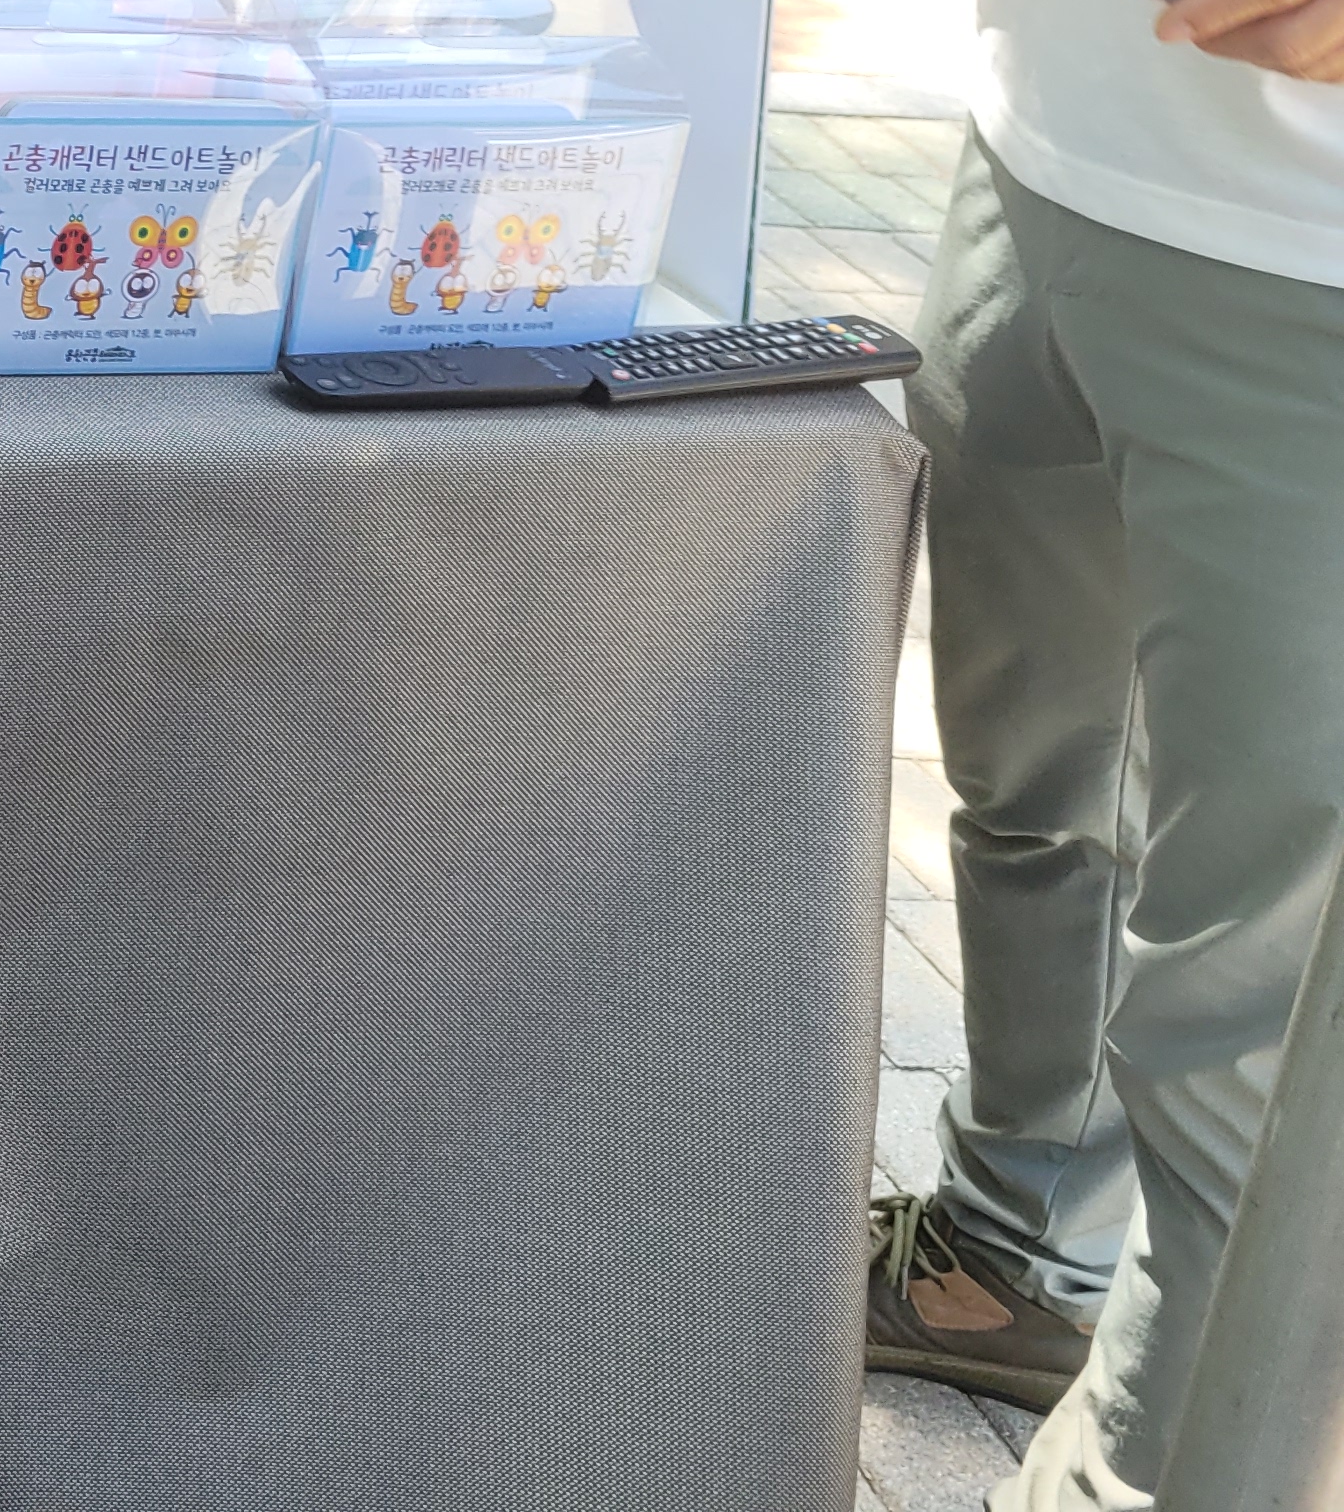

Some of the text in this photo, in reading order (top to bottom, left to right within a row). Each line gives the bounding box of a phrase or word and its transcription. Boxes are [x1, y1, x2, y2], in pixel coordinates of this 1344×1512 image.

[2, 144, 262, 175] 곤충캐릭터 샌드아트놀이
[378, 145, 625, 175] 곤충캐릭터 샌드아트놀이
[24, 178, 87, 194] 컬러모래로
[90, 178, 125, 194] 곤충을
[168, 178, 194, 193] 그려
